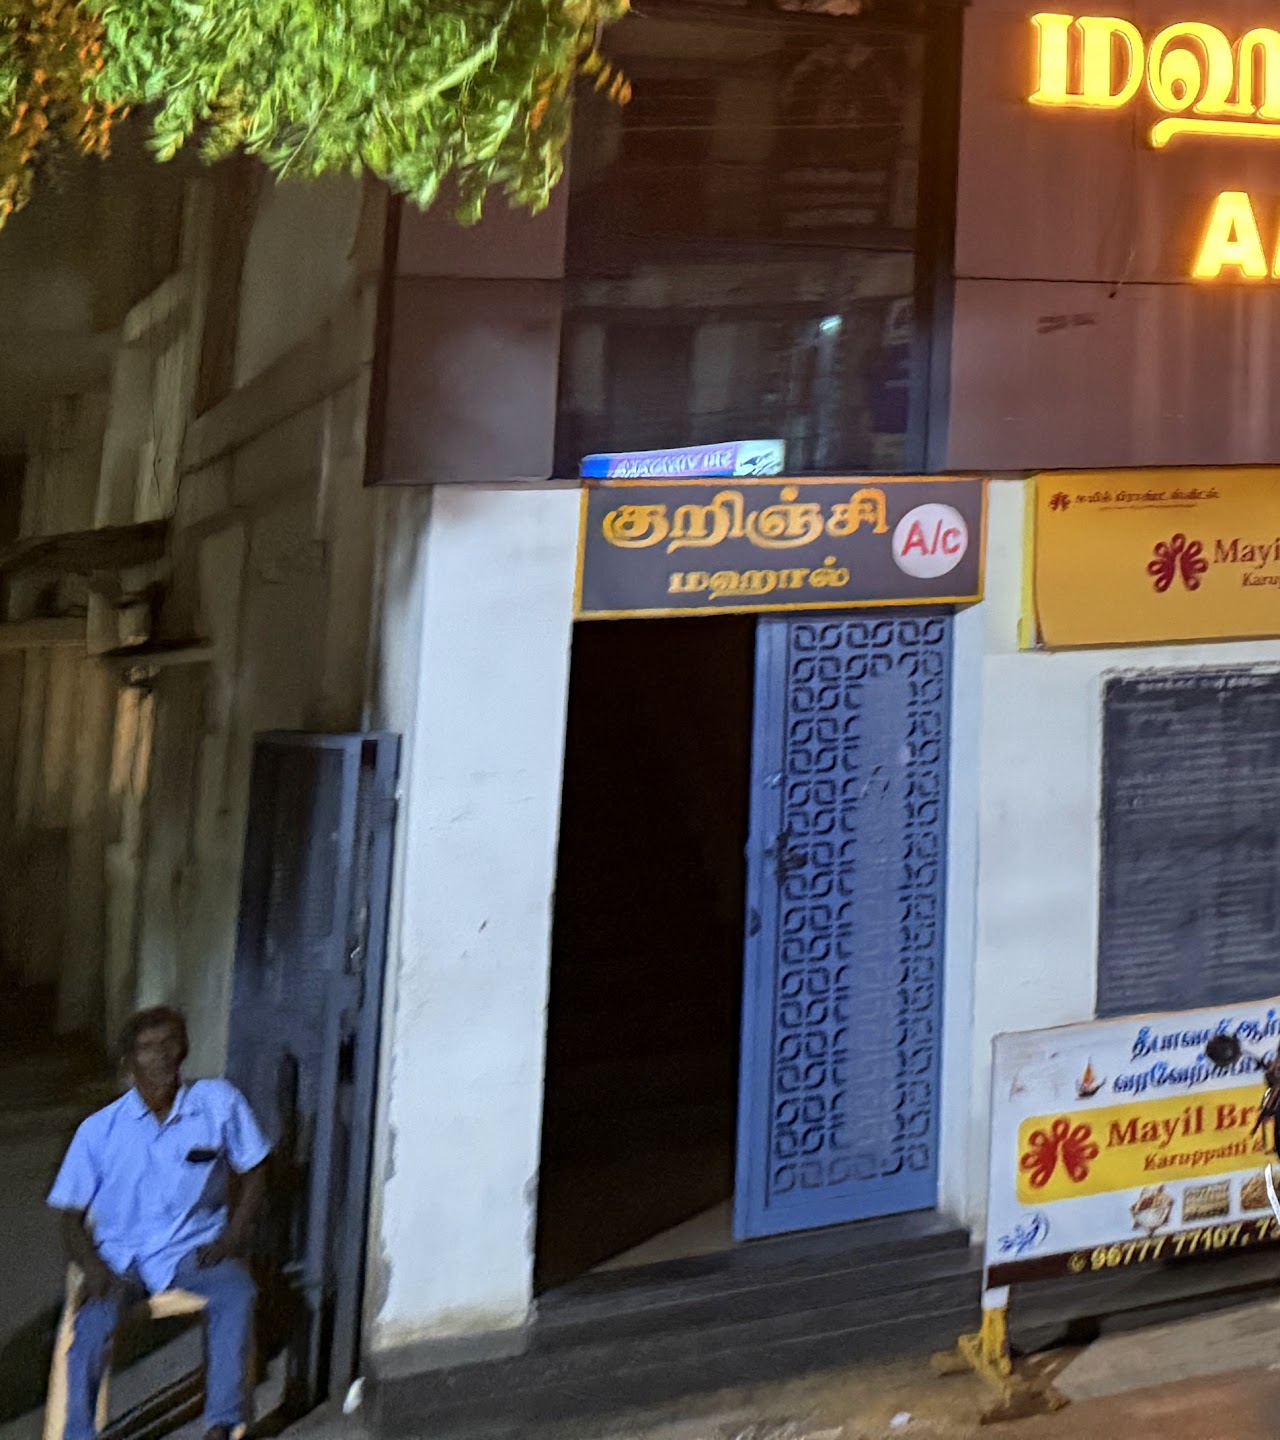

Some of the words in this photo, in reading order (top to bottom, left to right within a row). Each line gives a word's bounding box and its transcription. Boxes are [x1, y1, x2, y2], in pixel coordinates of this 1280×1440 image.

[602, 486, 890, 555] குறிஞ்சி
[667, 556, 850, 600] மஹால்
[1106, 1105, 1204, 1150] Mayil
[1143, 1137, 1249, 1172] Karuppatti
